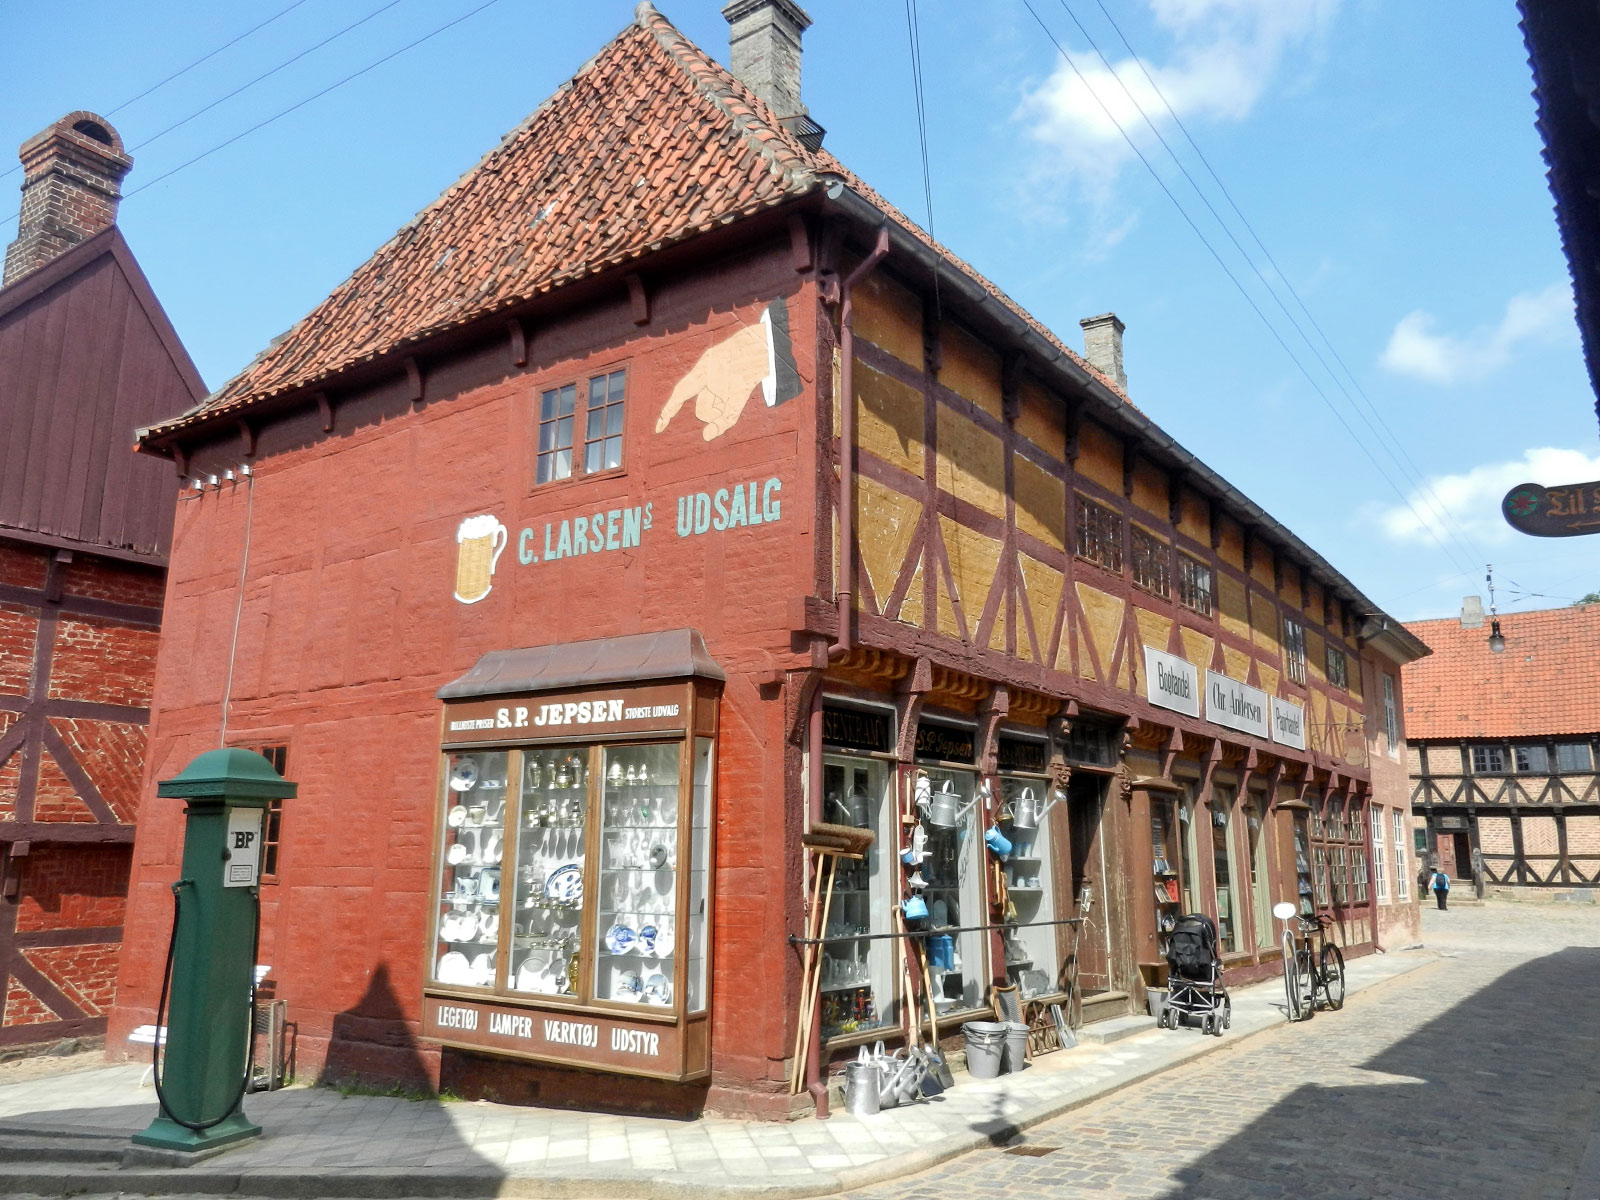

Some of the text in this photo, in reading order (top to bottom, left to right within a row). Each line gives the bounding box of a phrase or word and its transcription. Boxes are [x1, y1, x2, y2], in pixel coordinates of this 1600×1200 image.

[519, 527, 539, 565] C.
[677, 477, 782, 538] UDSALG
[535, 699, 624, 726] JEPSEN
[625, 706, 652, 720] STØRSTE
[652, 704, 680, 719] UDVALG
[1212, 682, 1262, 723] Chr. Andersen
[935, 732, 973, 759] Jepsen
[437, 1005, 660, 1056] LEGETØJ LAMPER VÆRKTØJ UDSTYR
